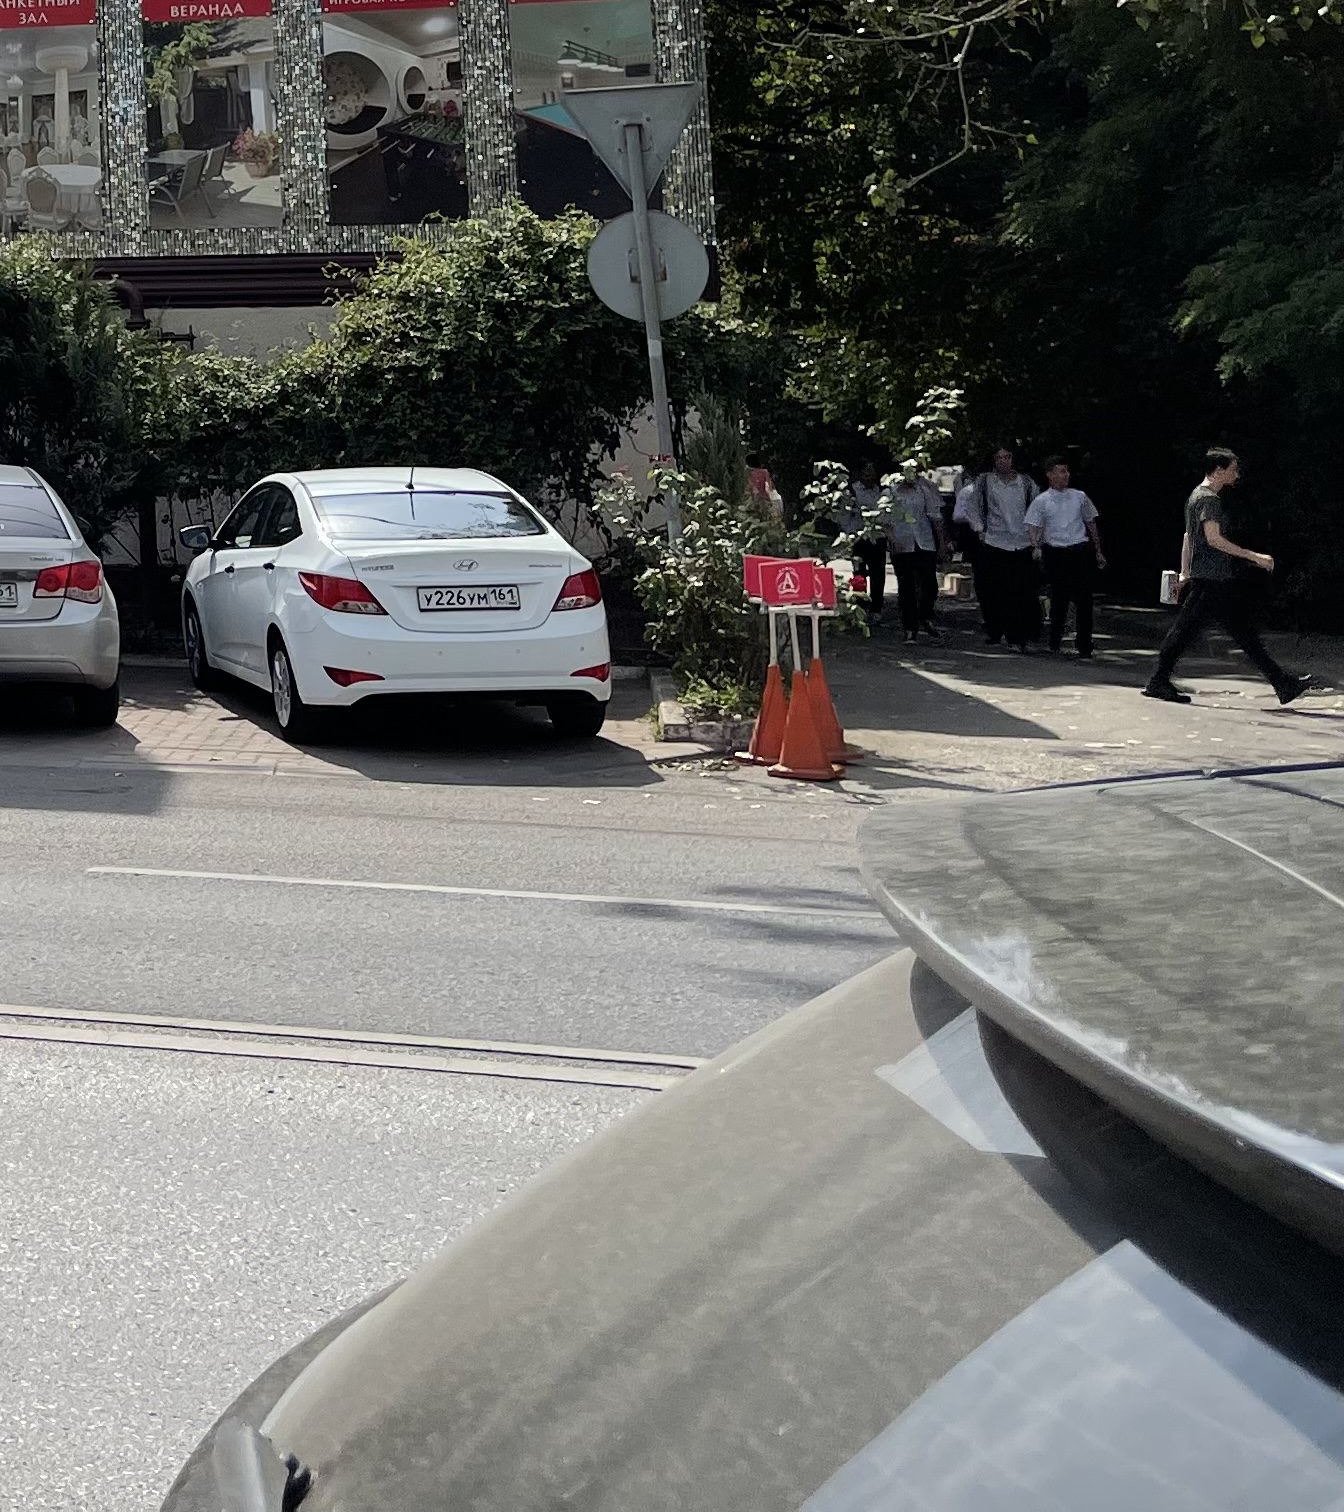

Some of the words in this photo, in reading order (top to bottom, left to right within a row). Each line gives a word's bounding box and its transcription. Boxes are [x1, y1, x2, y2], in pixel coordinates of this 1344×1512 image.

[18, 12, 48, 24] ЗАЛ
[170, 2, 244, 18] ВЕРАНДА
[424, 590, 489, 606] У226УМ
[490, 589, 515, 601] 161
